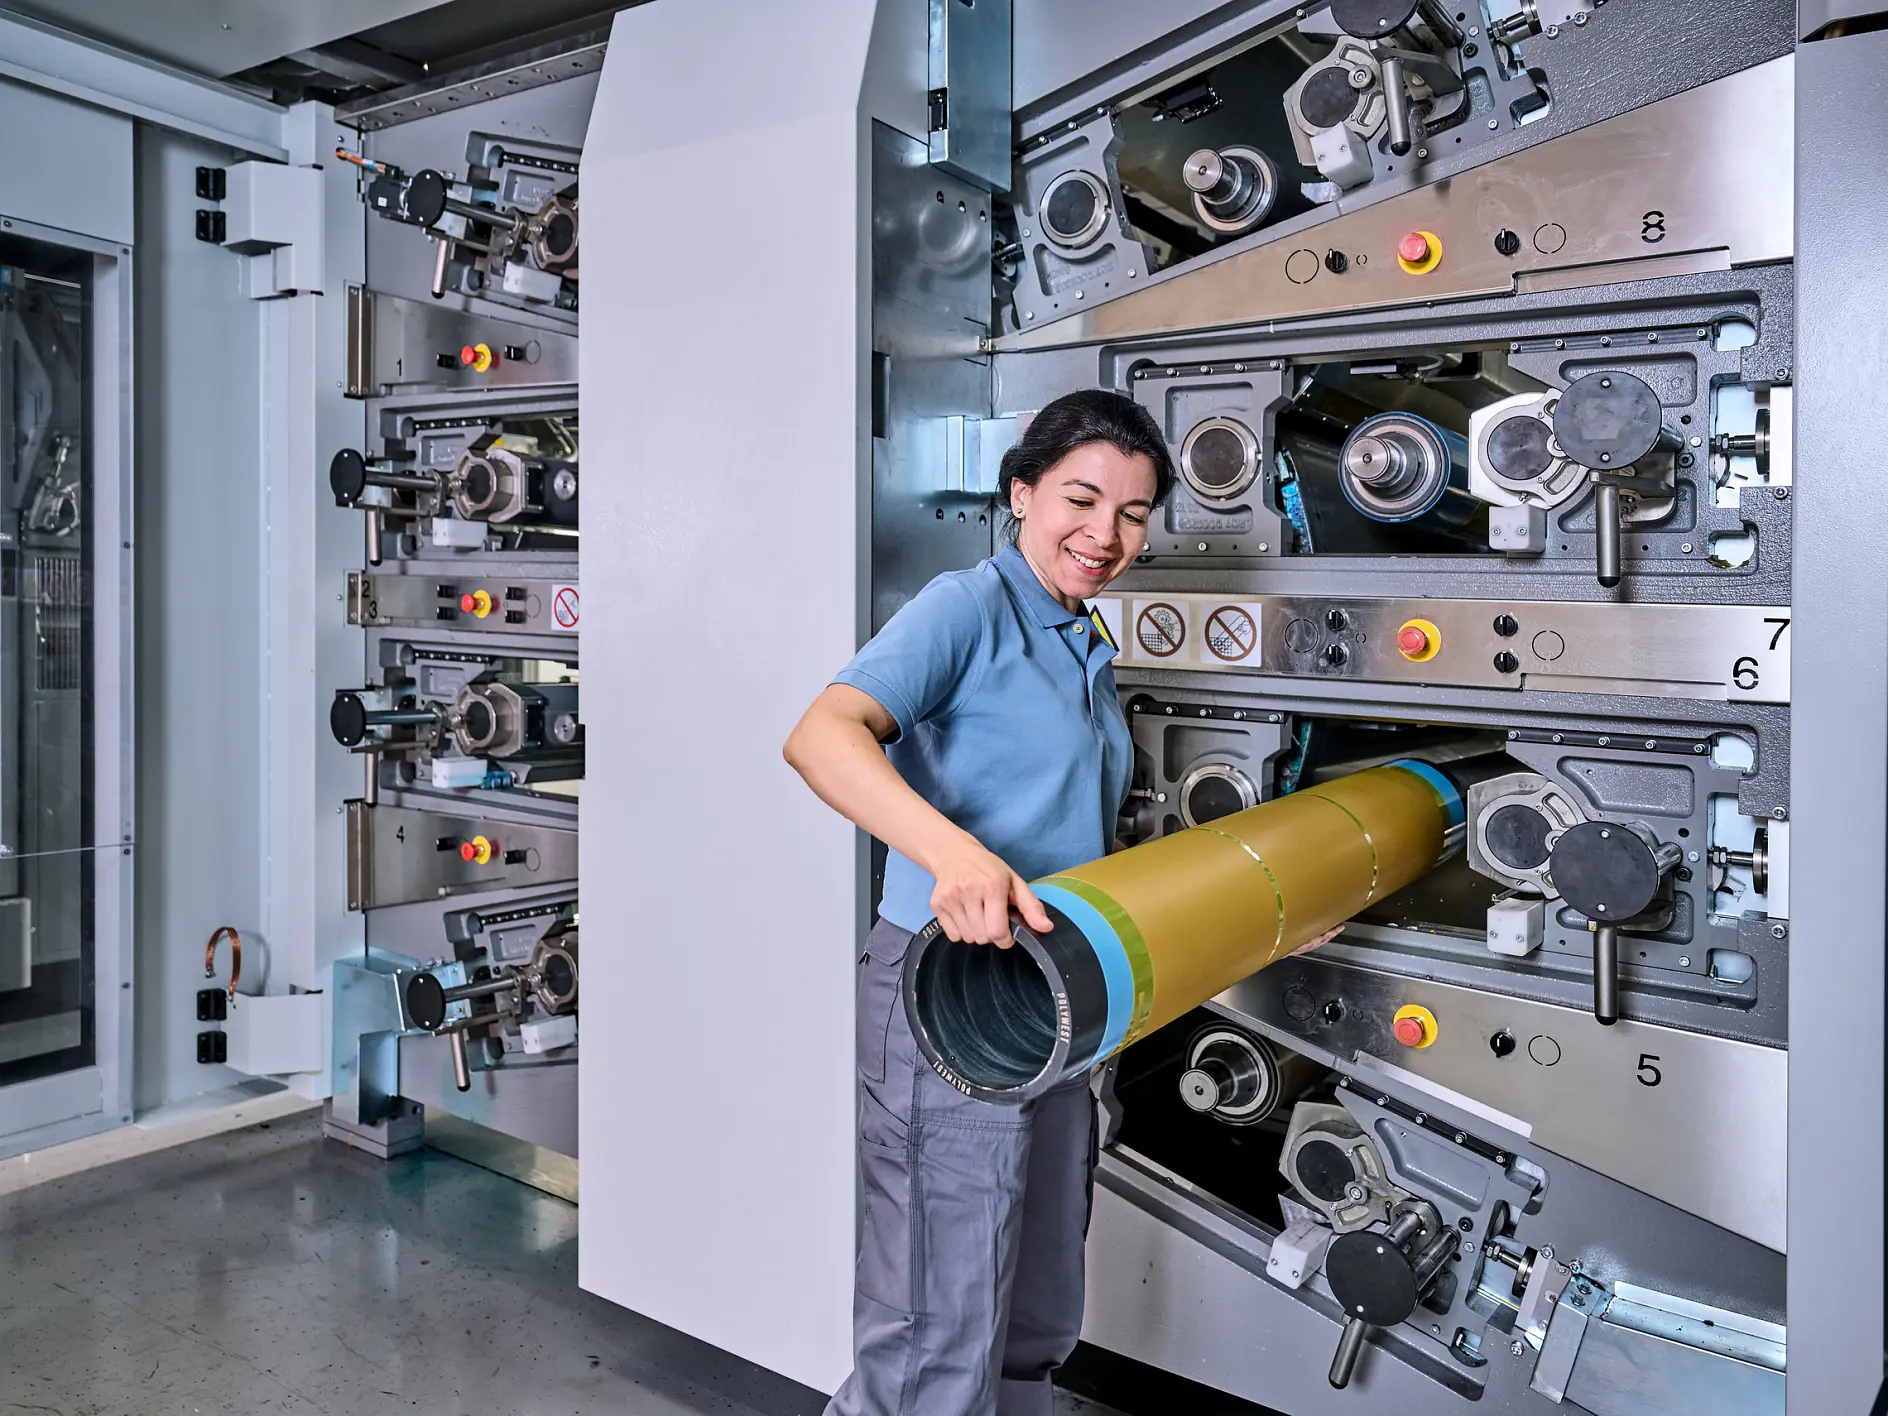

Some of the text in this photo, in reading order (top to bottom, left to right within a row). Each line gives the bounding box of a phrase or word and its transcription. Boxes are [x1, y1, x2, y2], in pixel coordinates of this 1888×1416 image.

[1641, 210, 1666, 244] 8
[397, 358, 402, 377] 1
[361, 580, 370, 598] 2
[369, 601, 378, 620] 3
[1763, 618, 1790, 650] 7
[1732, 656, 1759, 690] 6
[396, 825, 405, 844] 4
[922, 920, 940, 939] POLY
[1056, 992, 1070, 1045] POLYWEST
[932, 1060, 971, 1096] POLYWEST
[1636, 1053, 1662, 1087] 5
